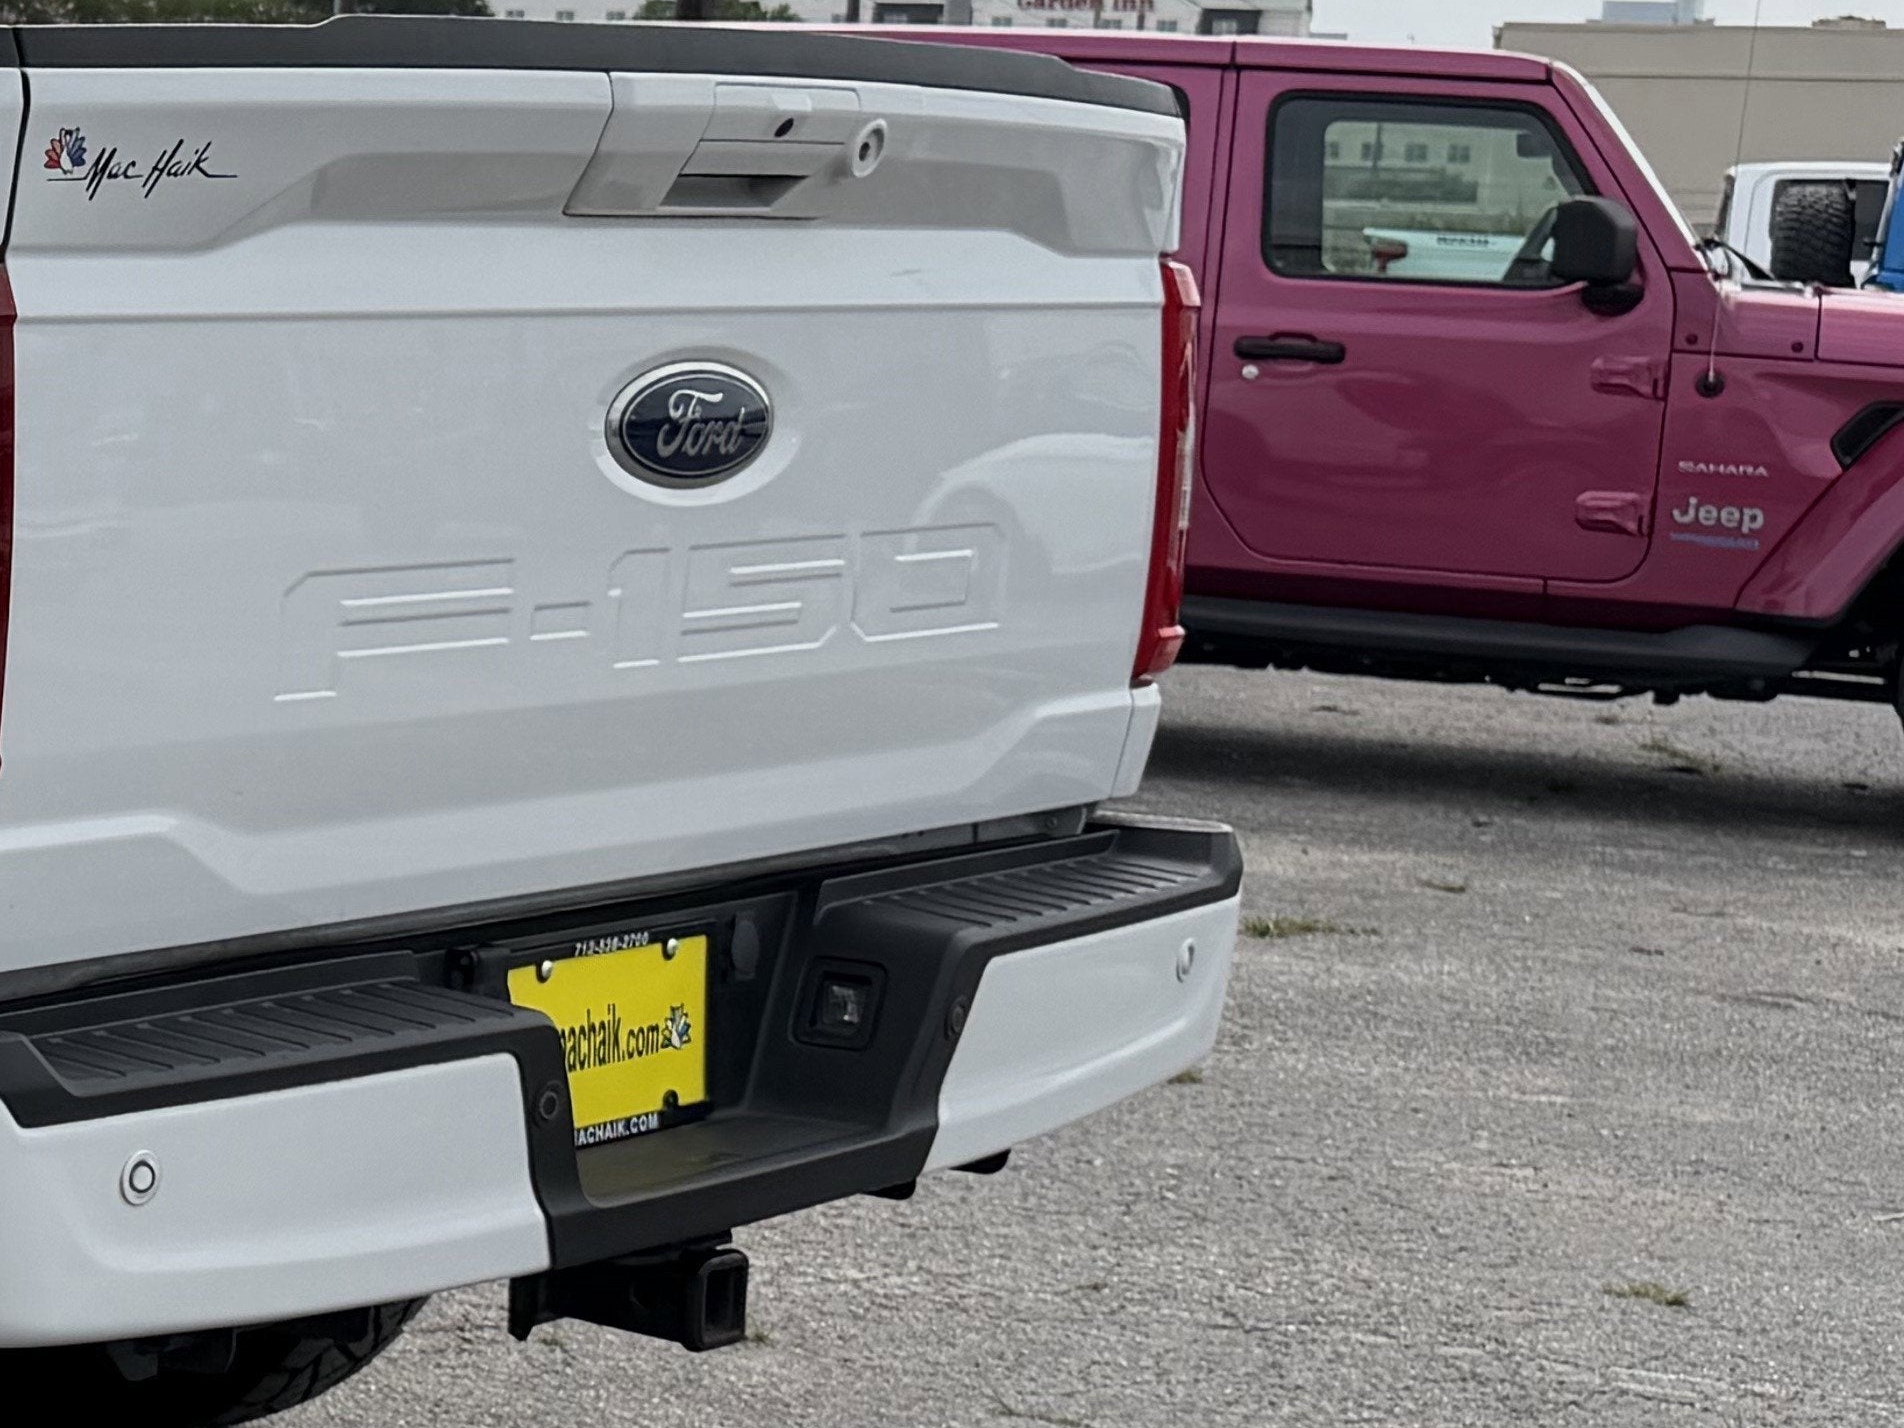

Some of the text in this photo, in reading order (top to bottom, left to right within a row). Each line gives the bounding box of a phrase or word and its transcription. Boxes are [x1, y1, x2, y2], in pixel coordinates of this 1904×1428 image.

[82, 138, 234, 201] Mac Haik
[655, 388, 750, 458] Ford
[1678, 460, 1769, 478] SAHARA
[1671, 495, 1765, 535] Jeep
[273, 522, 1010, 702] F-150
[574, 1112, 659, 1146] ACHAIK.COM
